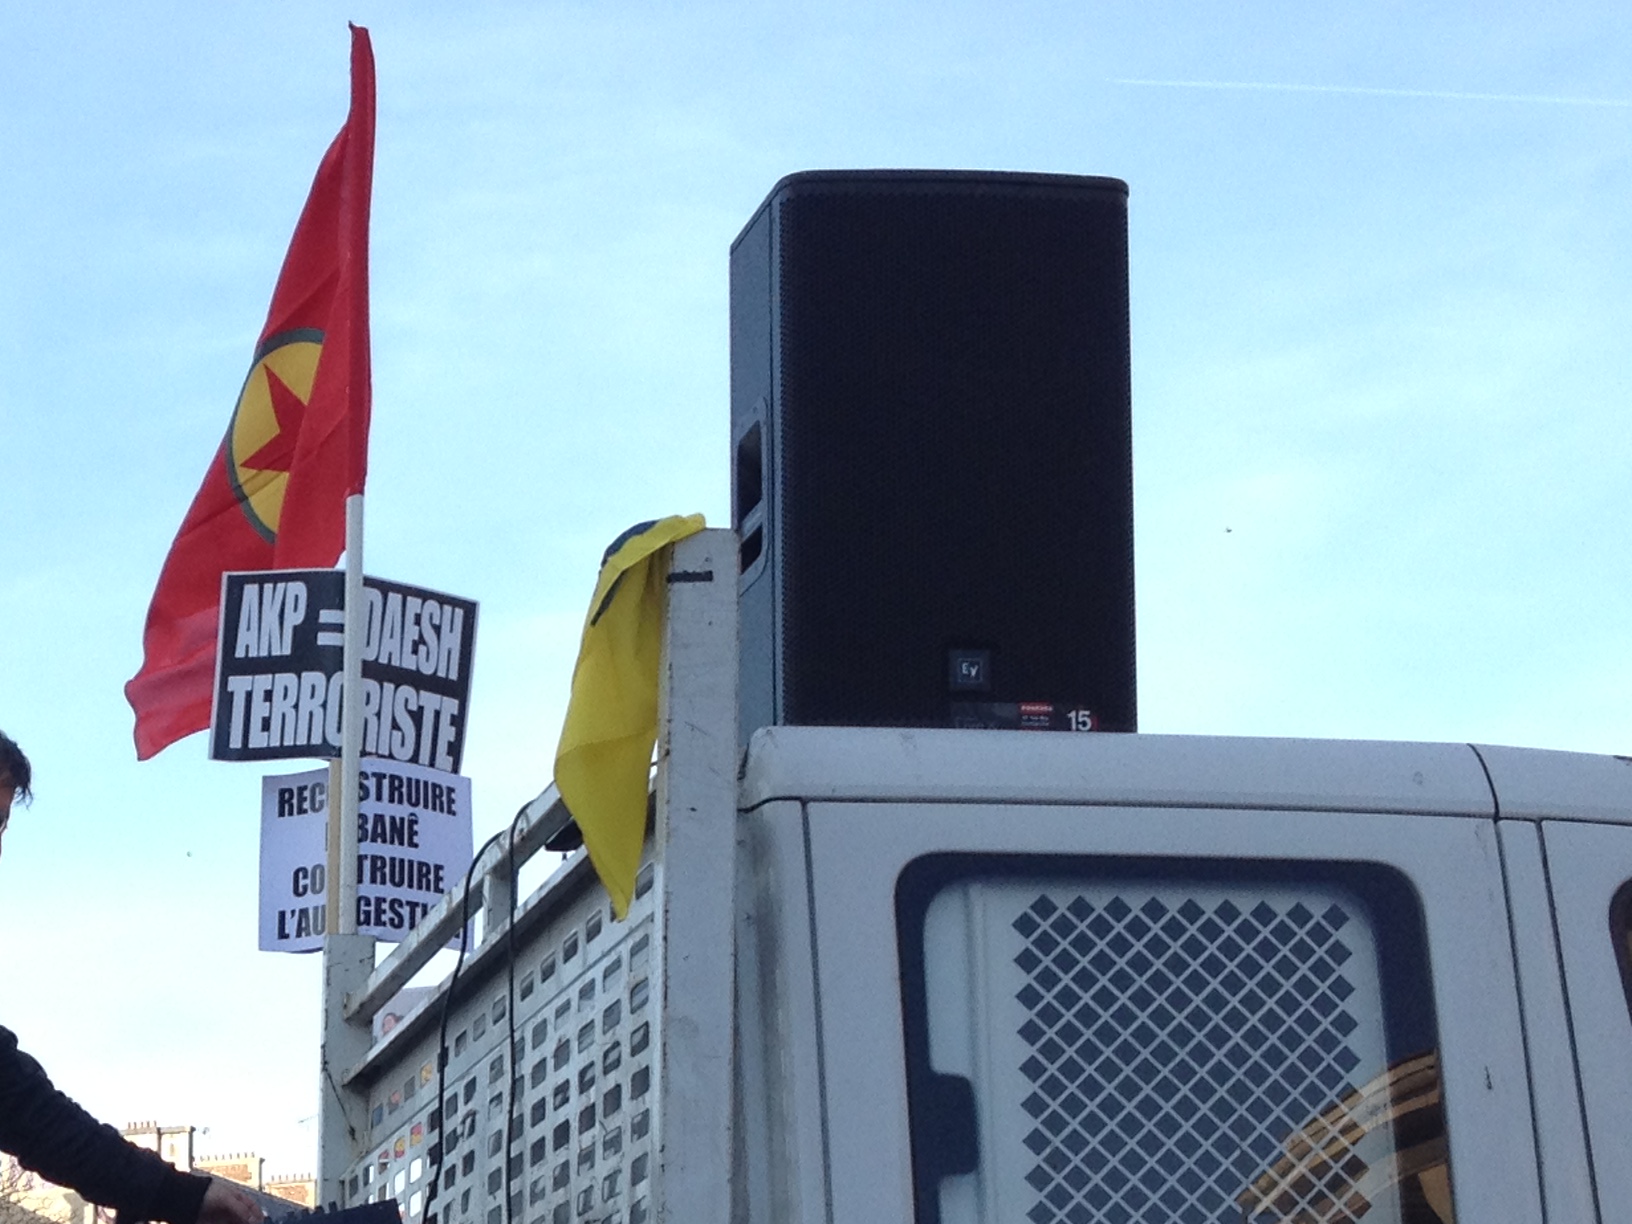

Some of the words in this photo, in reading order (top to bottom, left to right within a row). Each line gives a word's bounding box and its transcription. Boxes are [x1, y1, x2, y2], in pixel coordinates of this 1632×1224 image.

[234, 581, 308, 658] AKP
[361, 586, 464, 681] DAESH
[227, 671, 460, 773] TERRORISTE
[1067, 710, 1092, 731] 15
[277, 771, 457, 818] RECSTRUIRE
[325, 812, 420, 851] BANÊ
[292, 854, 445, 898] COTRUIRE
